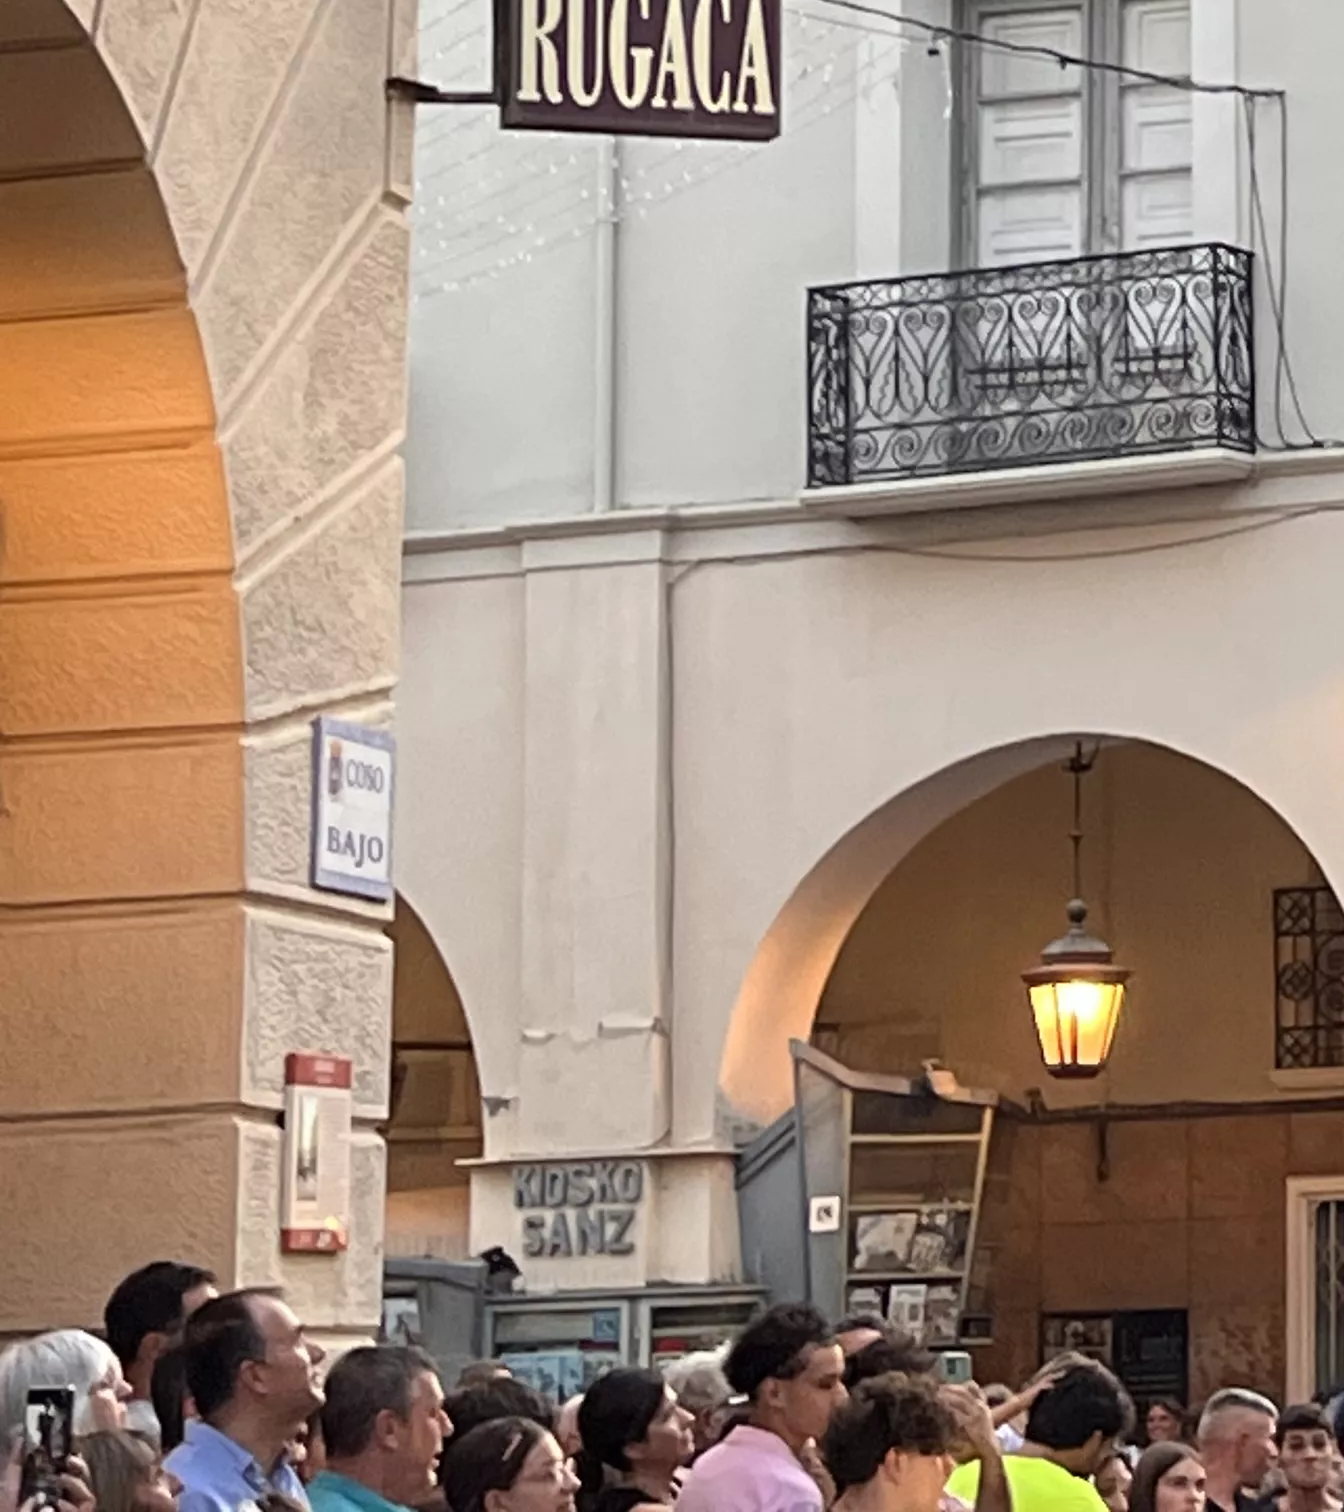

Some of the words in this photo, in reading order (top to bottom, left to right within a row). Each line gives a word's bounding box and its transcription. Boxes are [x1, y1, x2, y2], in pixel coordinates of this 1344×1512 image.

[345, 758, 385, 794] COSO
[326, 825, 384, 869] BAJO
[513, 1162, 644, 1209] KIOSKO
[522, 1207, 636, 1258] SANZ
